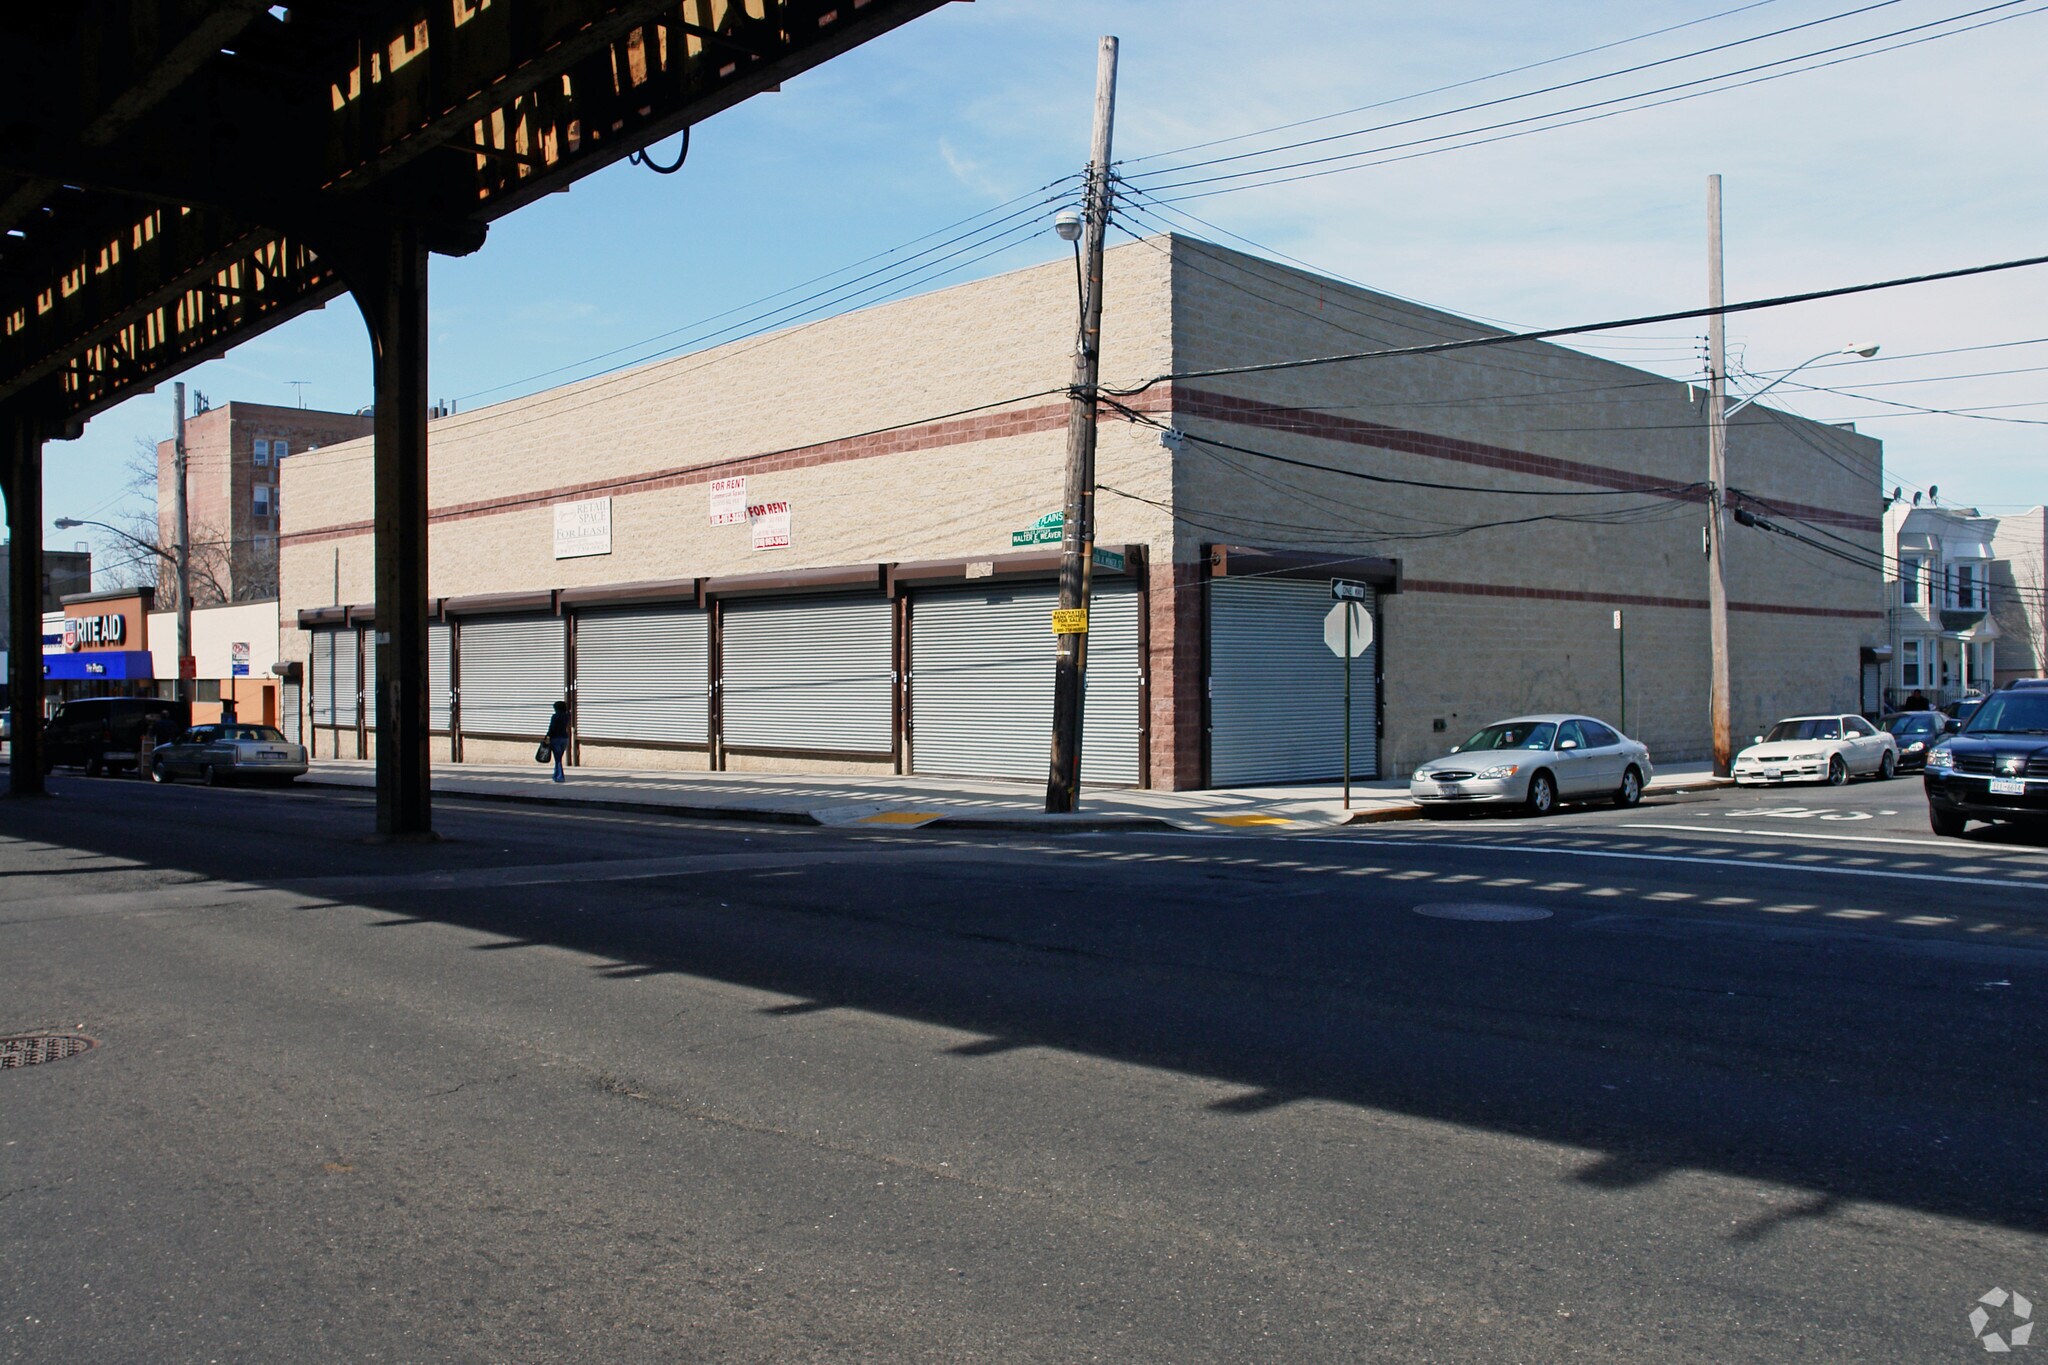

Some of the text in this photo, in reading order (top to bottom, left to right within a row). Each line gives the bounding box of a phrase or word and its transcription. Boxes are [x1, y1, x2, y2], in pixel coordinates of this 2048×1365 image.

[711, 478, 745, 492] FOR RENT
[577, 500, 609, 514] RETAIL
[747, 504, 767, 518] FOR
[767, 501, 788, 514] RENT
[579, 511, 607, 523] SPACE
[1040, 511, 1063, 525] PLAINS
[556, 524, 609, 540] FOR LEASE
[1013, 534, 1033, 543] WALTER
[1040, 531, 1062, 540] WEAVER
[1343, 586, 1353, 595] ONE
[77, 613, 121, 642] RITE AID
